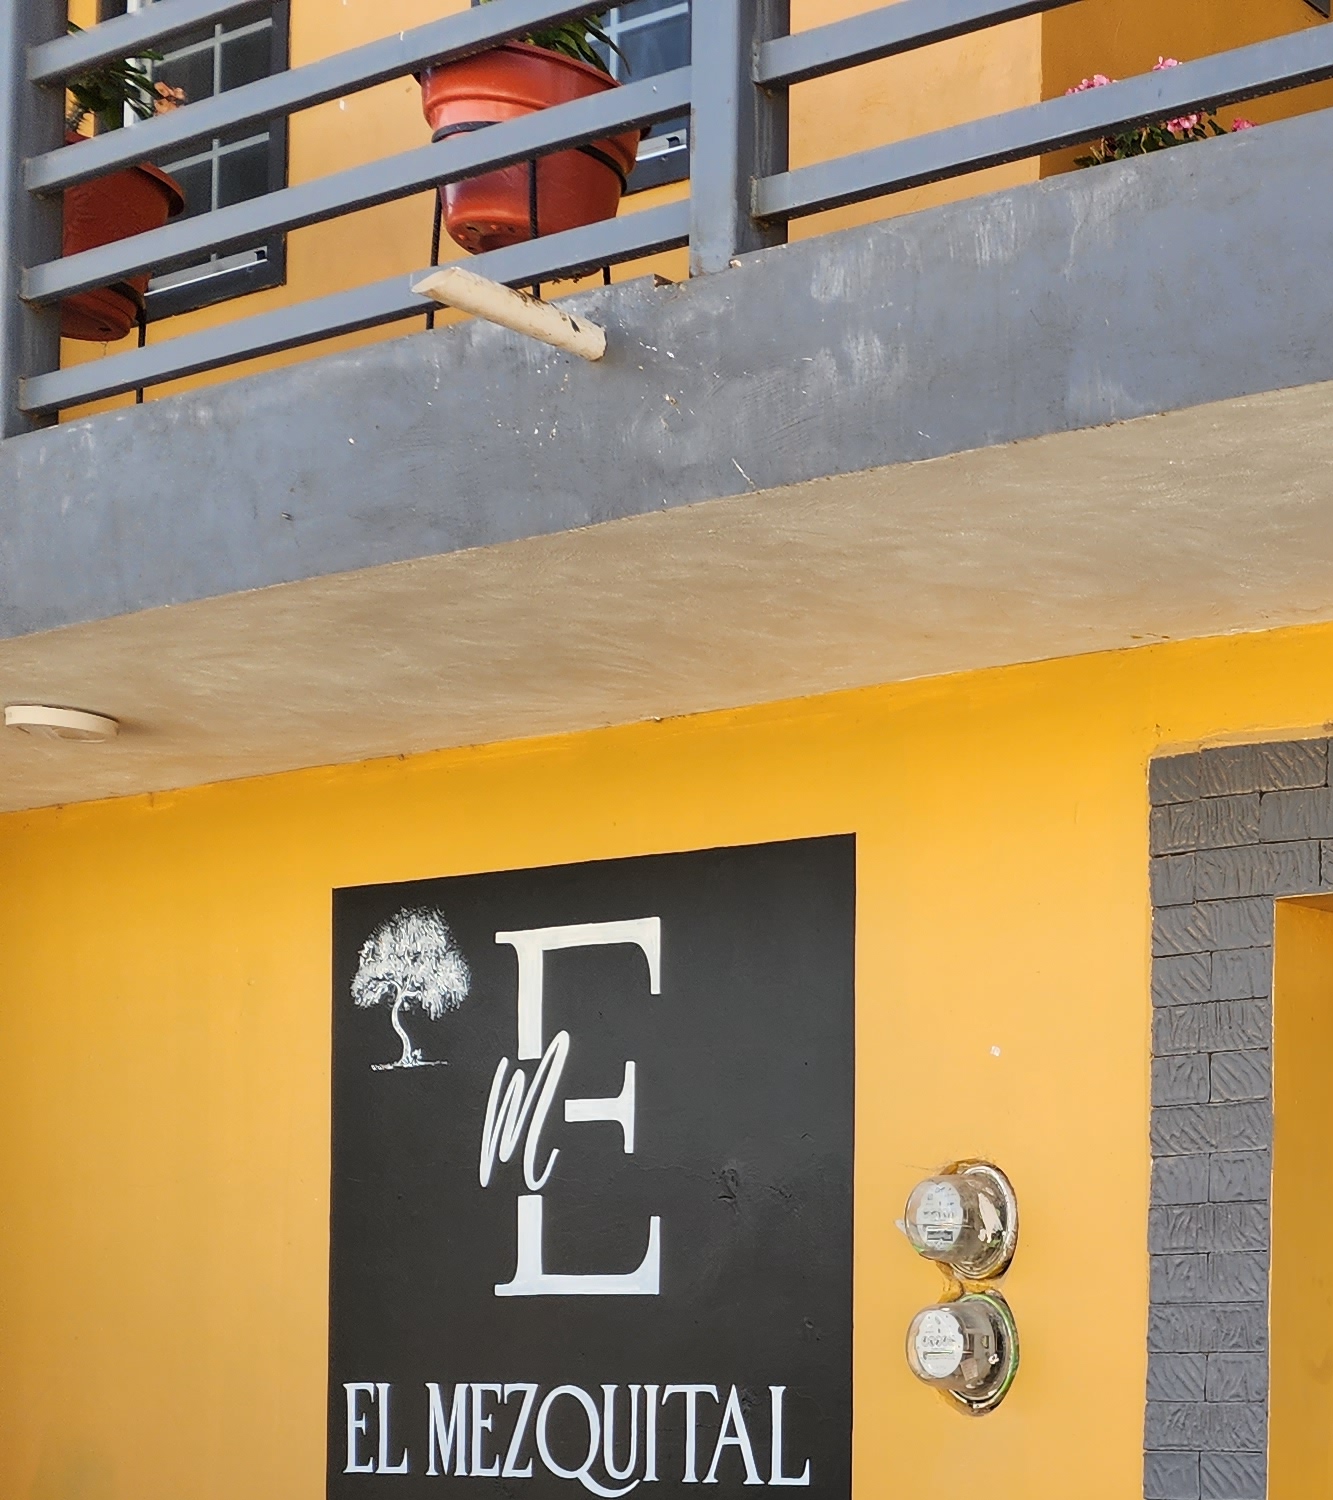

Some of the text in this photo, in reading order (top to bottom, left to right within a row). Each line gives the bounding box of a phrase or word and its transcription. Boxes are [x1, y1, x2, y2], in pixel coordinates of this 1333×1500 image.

[495, 916, 661, 1296] E
[342, 1382, 811, 1499] EL MEZQUITAL
